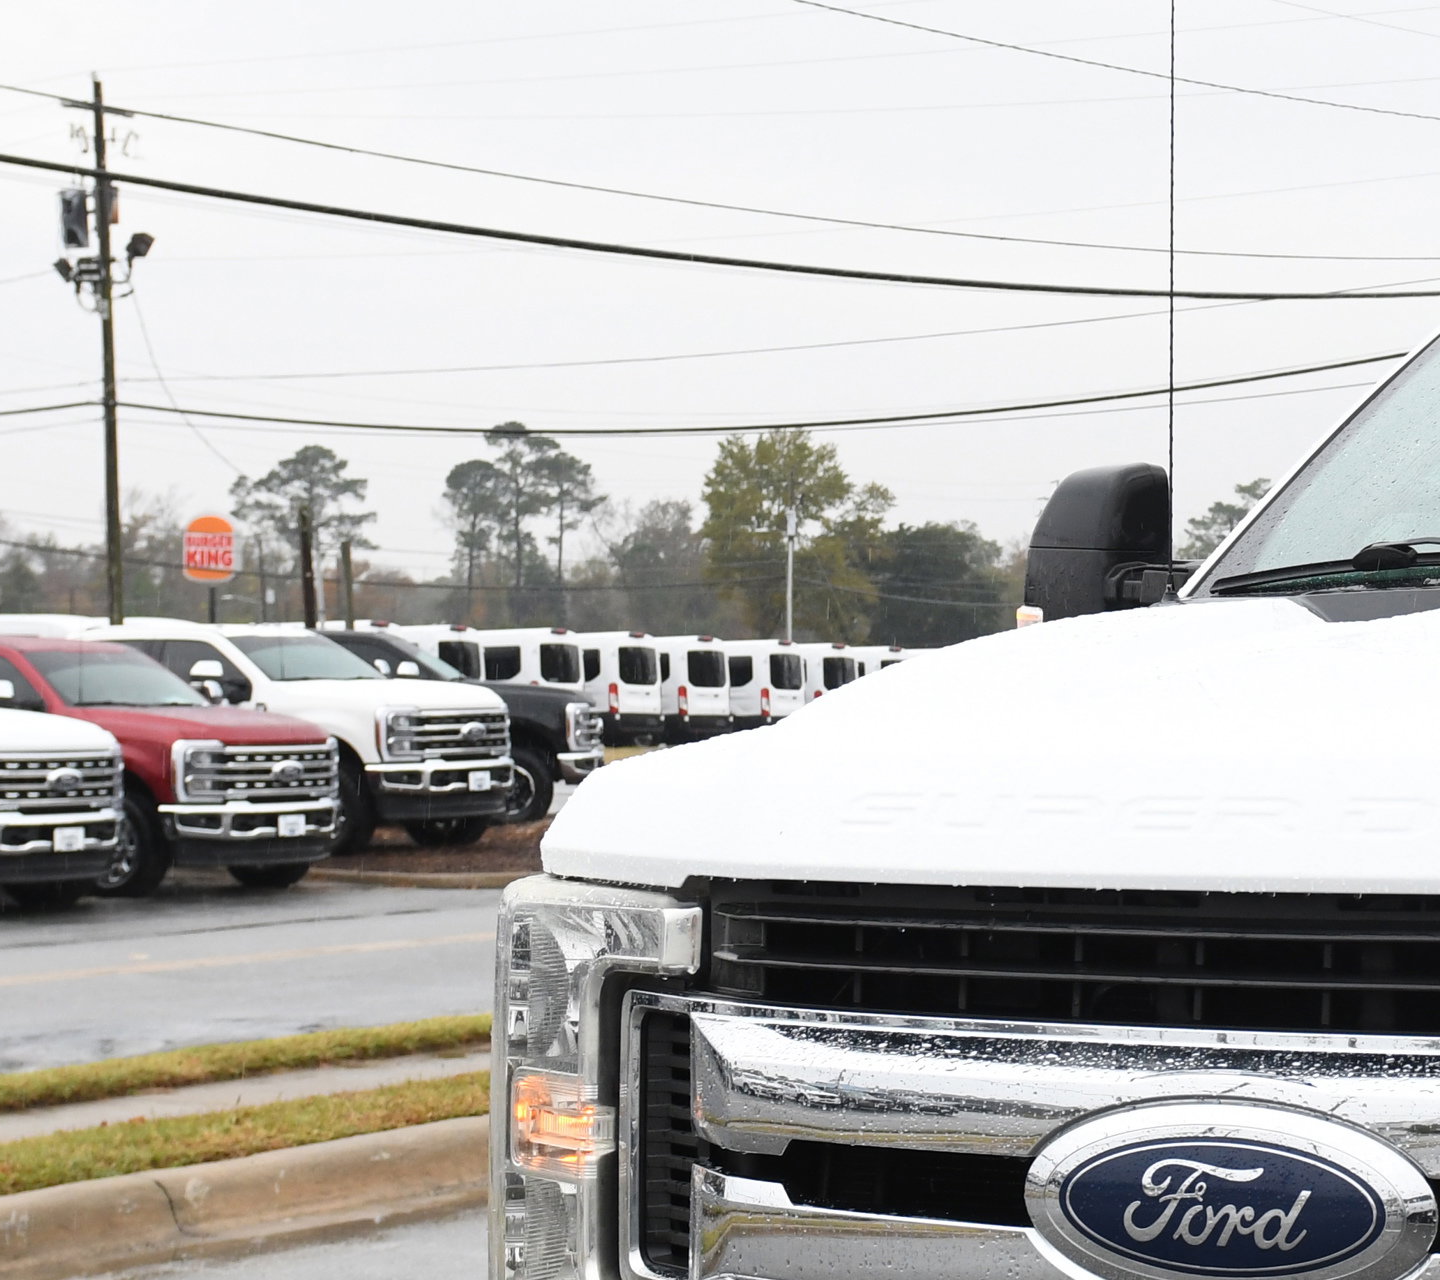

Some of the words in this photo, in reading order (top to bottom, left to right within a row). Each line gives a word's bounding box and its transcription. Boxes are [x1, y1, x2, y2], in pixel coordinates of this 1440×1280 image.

[186, 551, 233, 567] KING
[832, 792, 1303, 837] SUPER
[1123, 1158, 1312, 1252] Ford
